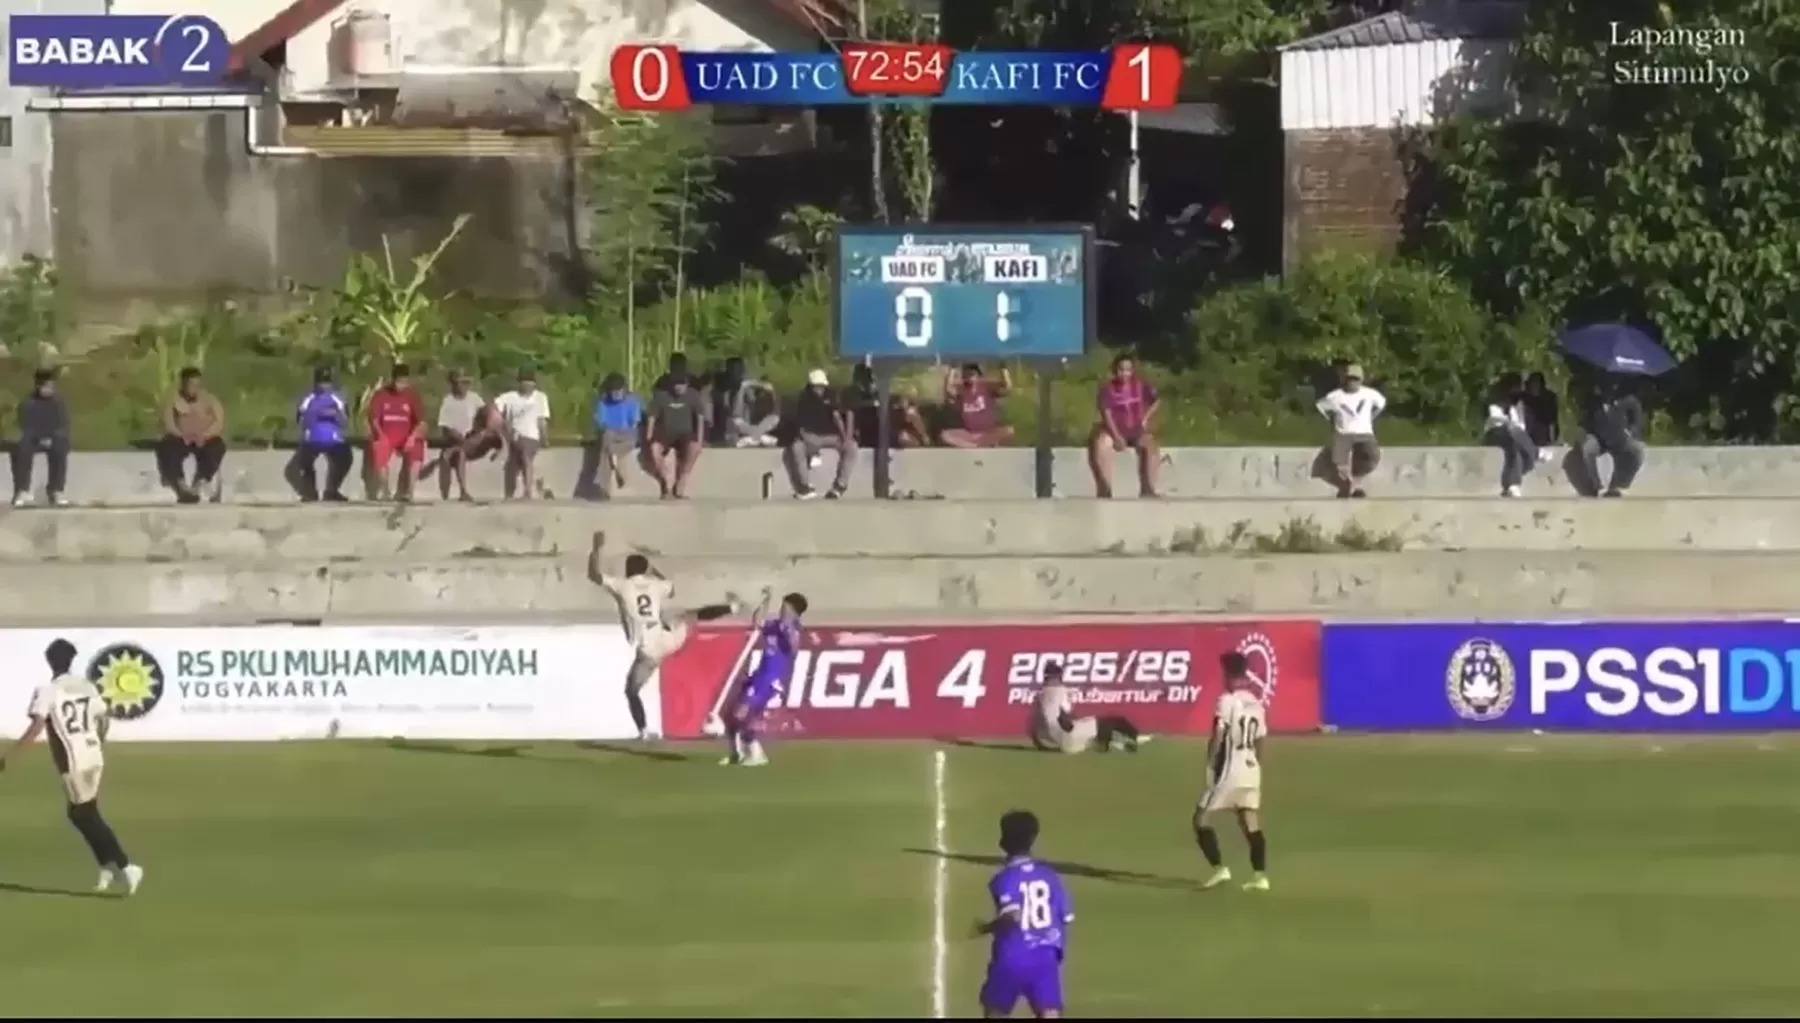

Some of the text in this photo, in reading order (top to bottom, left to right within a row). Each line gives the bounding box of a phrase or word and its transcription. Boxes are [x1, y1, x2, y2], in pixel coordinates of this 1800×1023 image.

[889, 261, 937, 278] UAD FC
[994, 259, 1039, 279] KAFI
[896, 287, 933, 347] 0
[997, 290, 1009, 342] 1
[636, 594, 653, 616] 2
[177, 649, 538, 677] RS PKU MUHAMMADIYAH
[178, 680, 348, 699] YOGYAKARTA
[936, 649, 987, 709] 4
[1167, 685, 1203, 702] DIY
[61, 696, 90, 734] 27
[1019, 880, 1051, 931] 18
